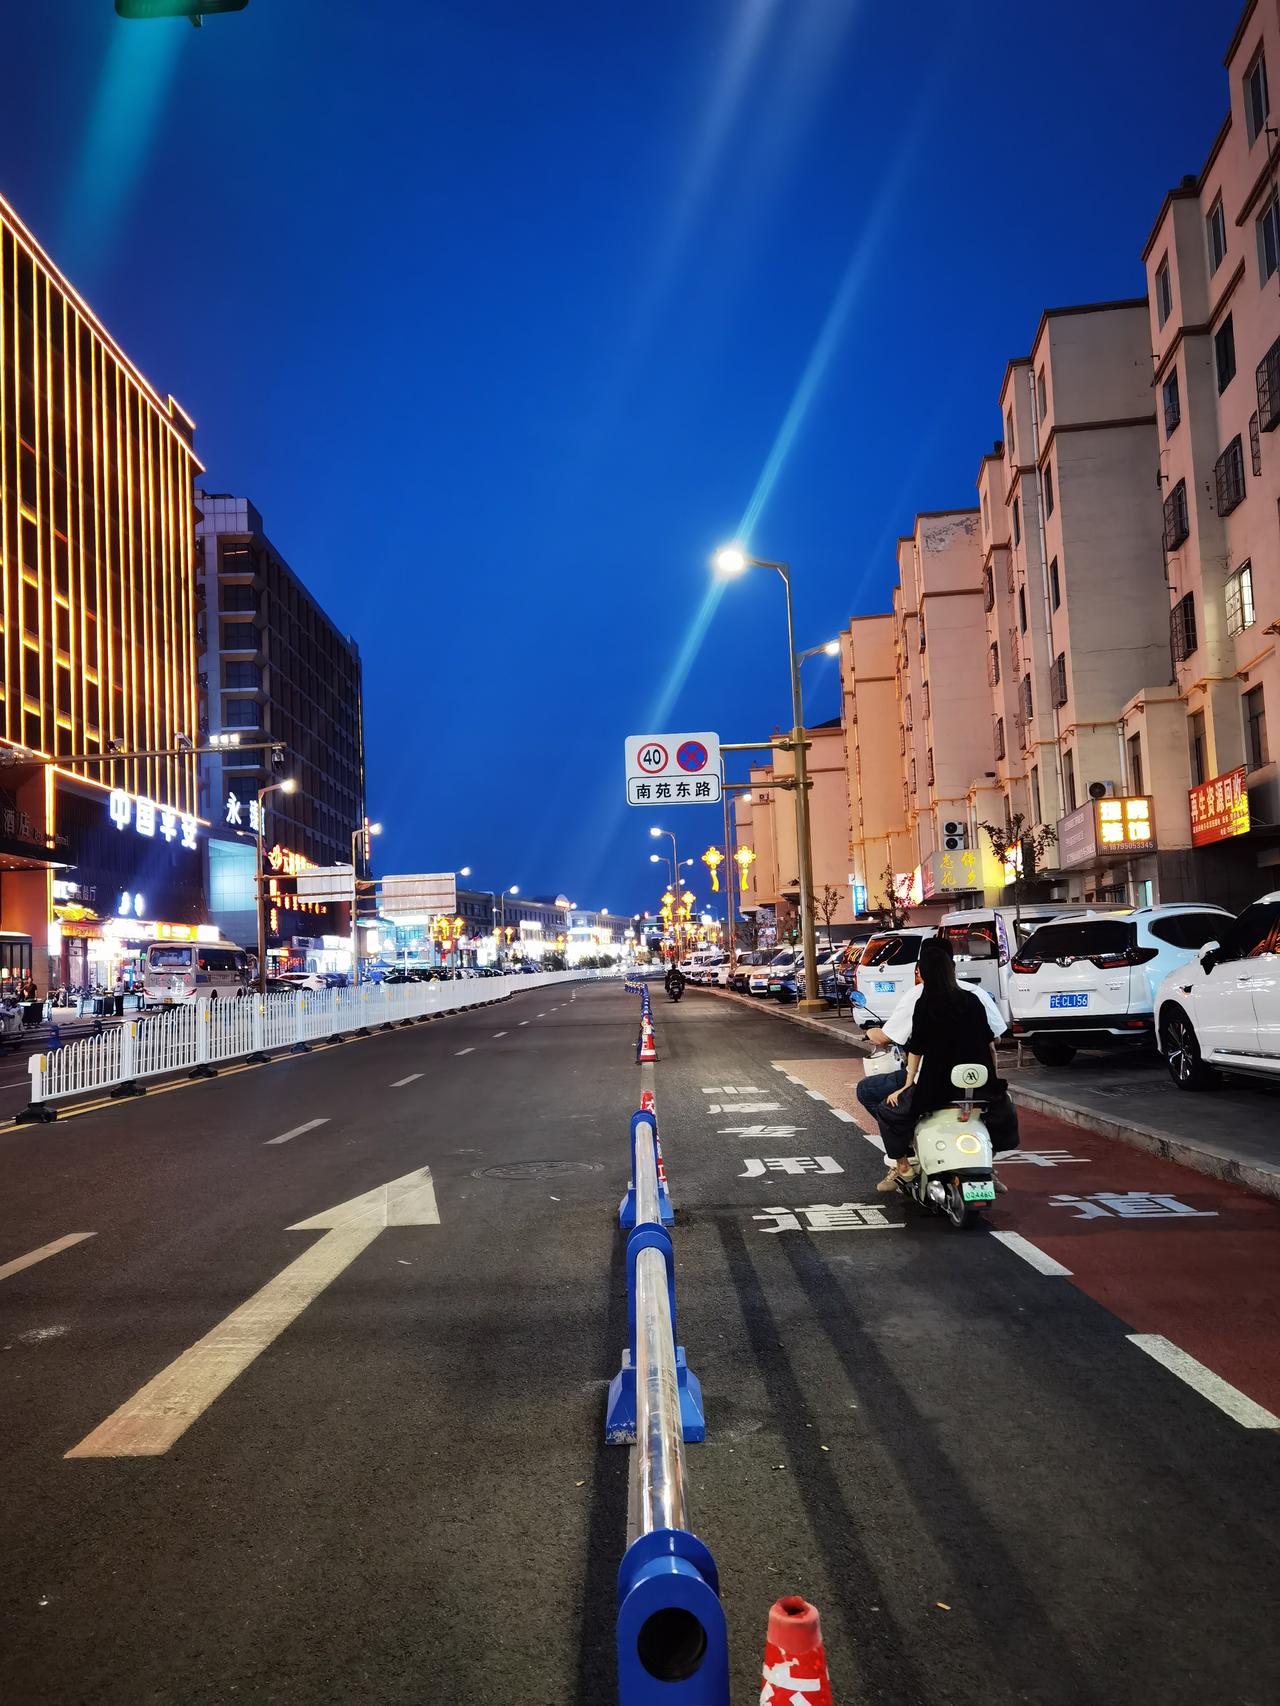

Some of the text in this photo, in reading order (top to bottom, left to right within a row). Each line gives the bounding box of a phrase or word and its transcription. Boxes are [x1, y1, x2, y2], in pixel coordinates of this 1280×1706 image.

[643, 749, 661, 765] 40
[636, 781, 711, 799] 南苑东路
[1190, 773, 1242, 823] 再生资源回收
[110, 788, 197, 850] 中国平安
